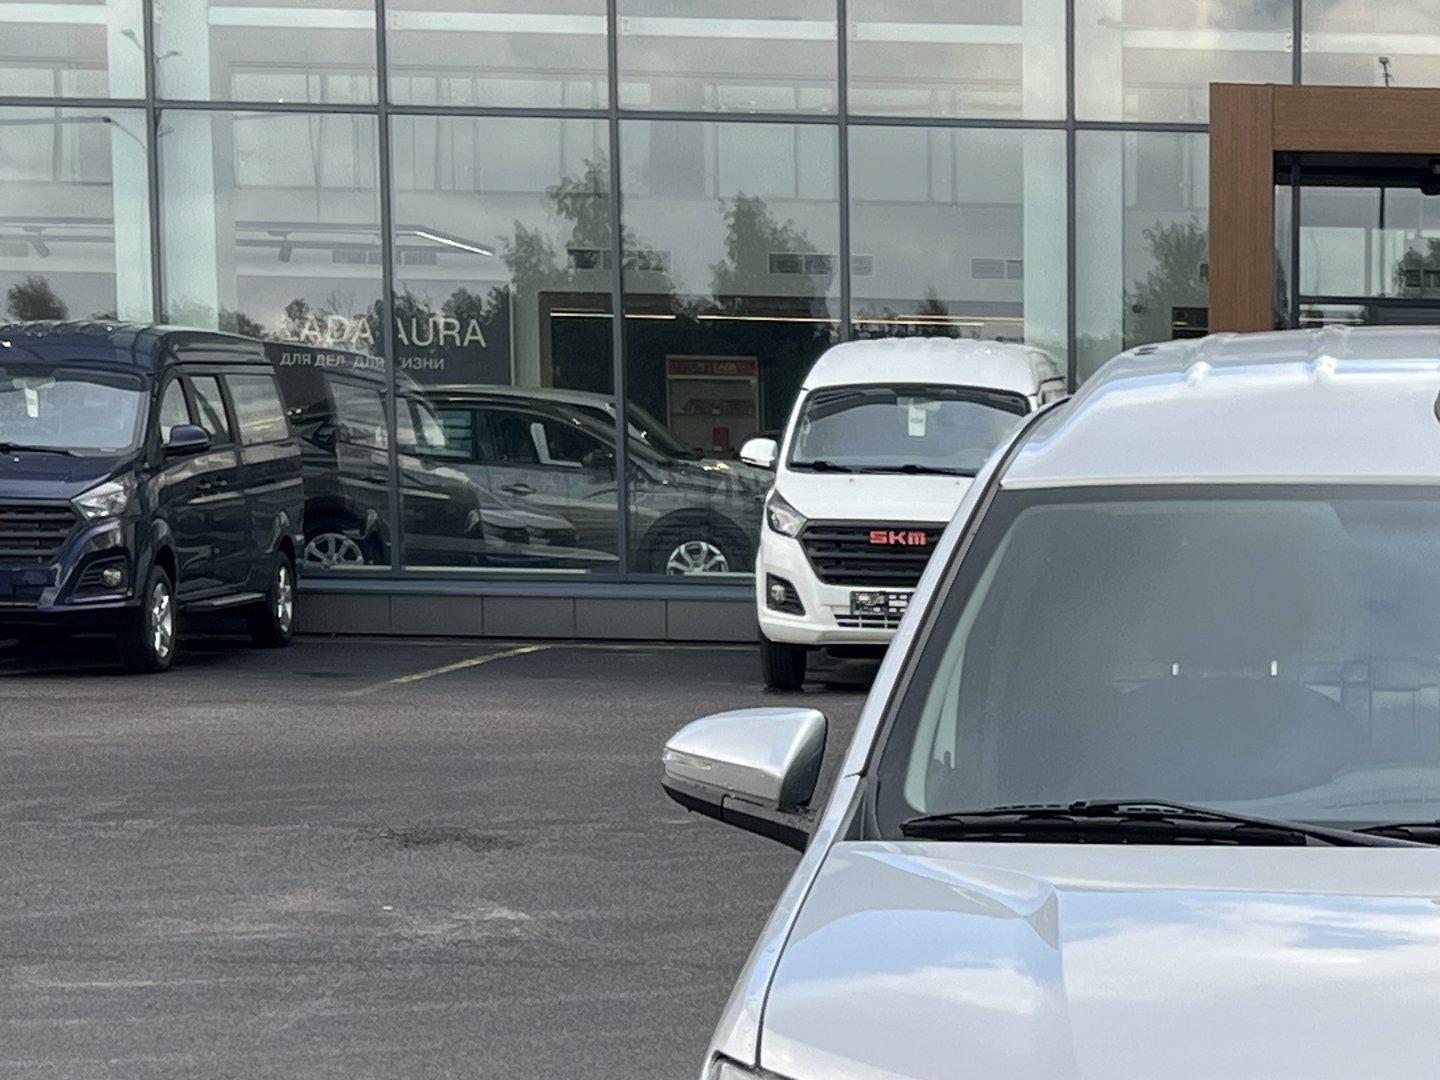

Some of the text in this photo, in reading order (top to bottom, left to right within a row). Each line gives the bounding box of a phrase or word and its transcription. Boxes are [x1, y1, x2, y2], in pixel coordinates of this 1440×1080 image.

[280, 352, 311, 366] ДЛЯ
[399, 356, 446, 370] ИЗНИ
[869, 531, 926, 546] SKM
